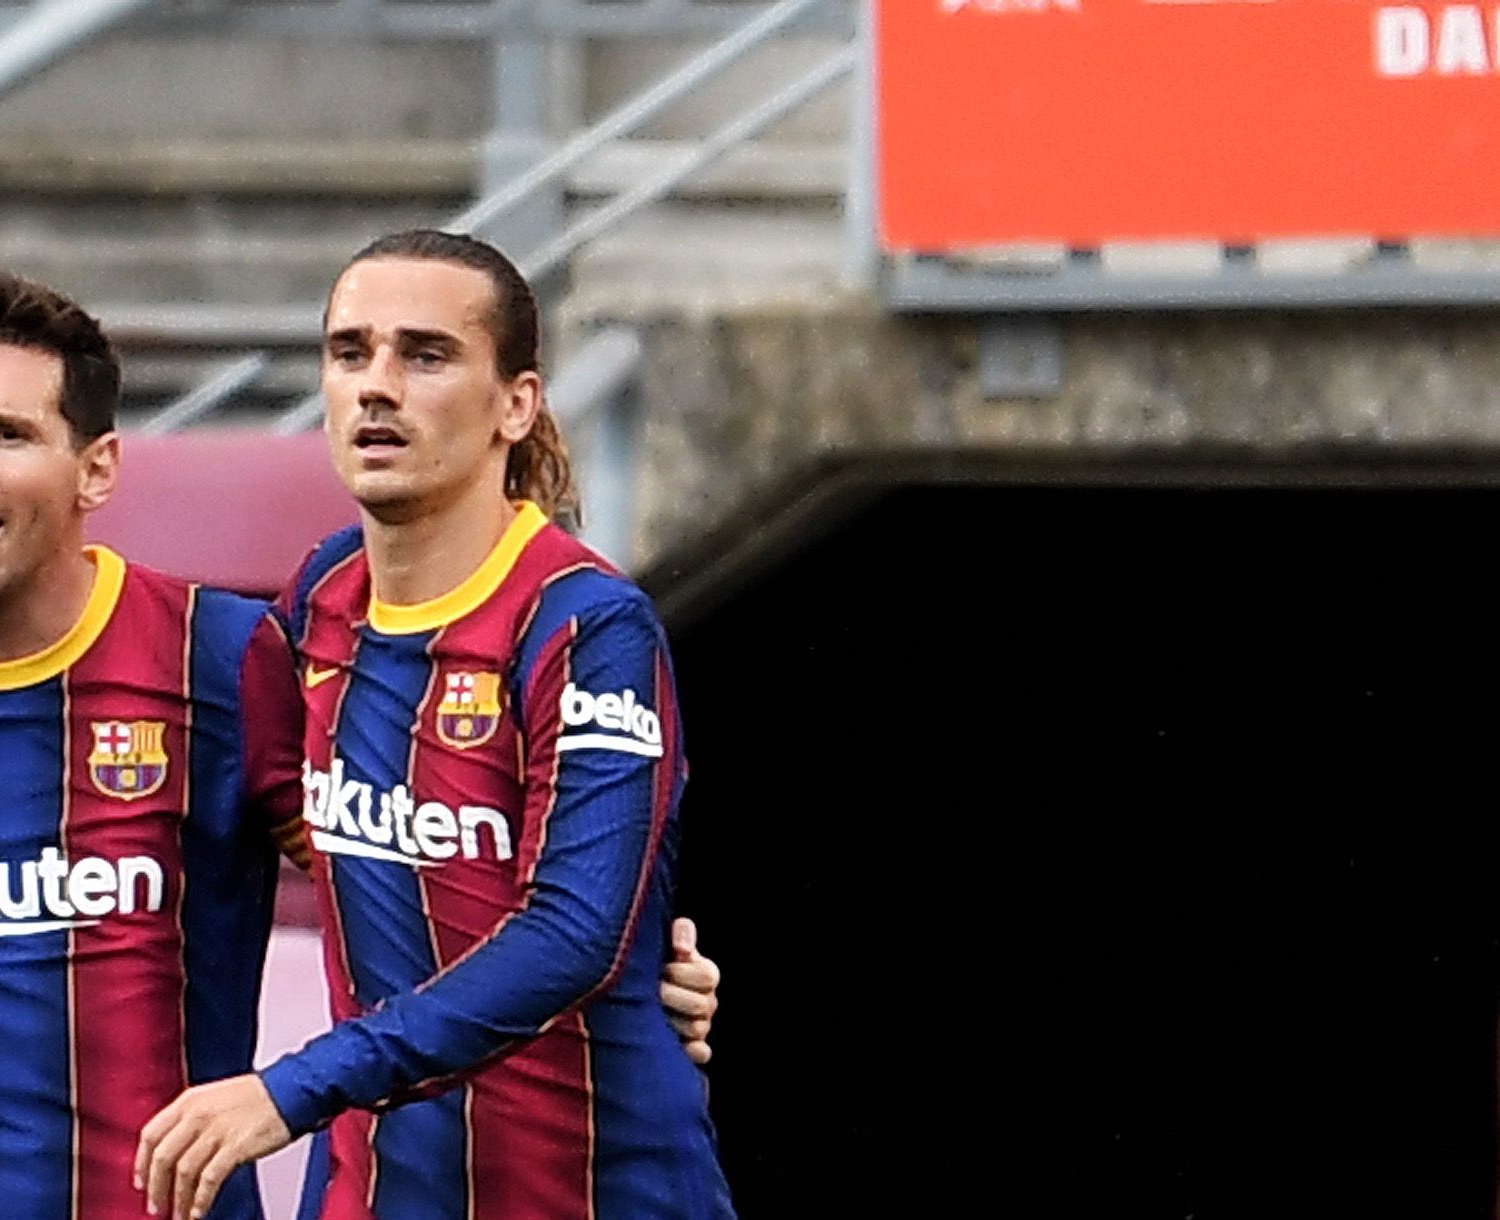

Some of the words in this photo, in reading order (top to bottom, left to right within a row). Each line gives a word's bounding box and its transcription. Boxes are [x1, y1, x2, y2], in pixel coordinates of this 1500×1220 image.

[1374, 4, 1500, 76] DA
[559, 682, 662, 745] beko
[301, 757, 513, 861] akuten
